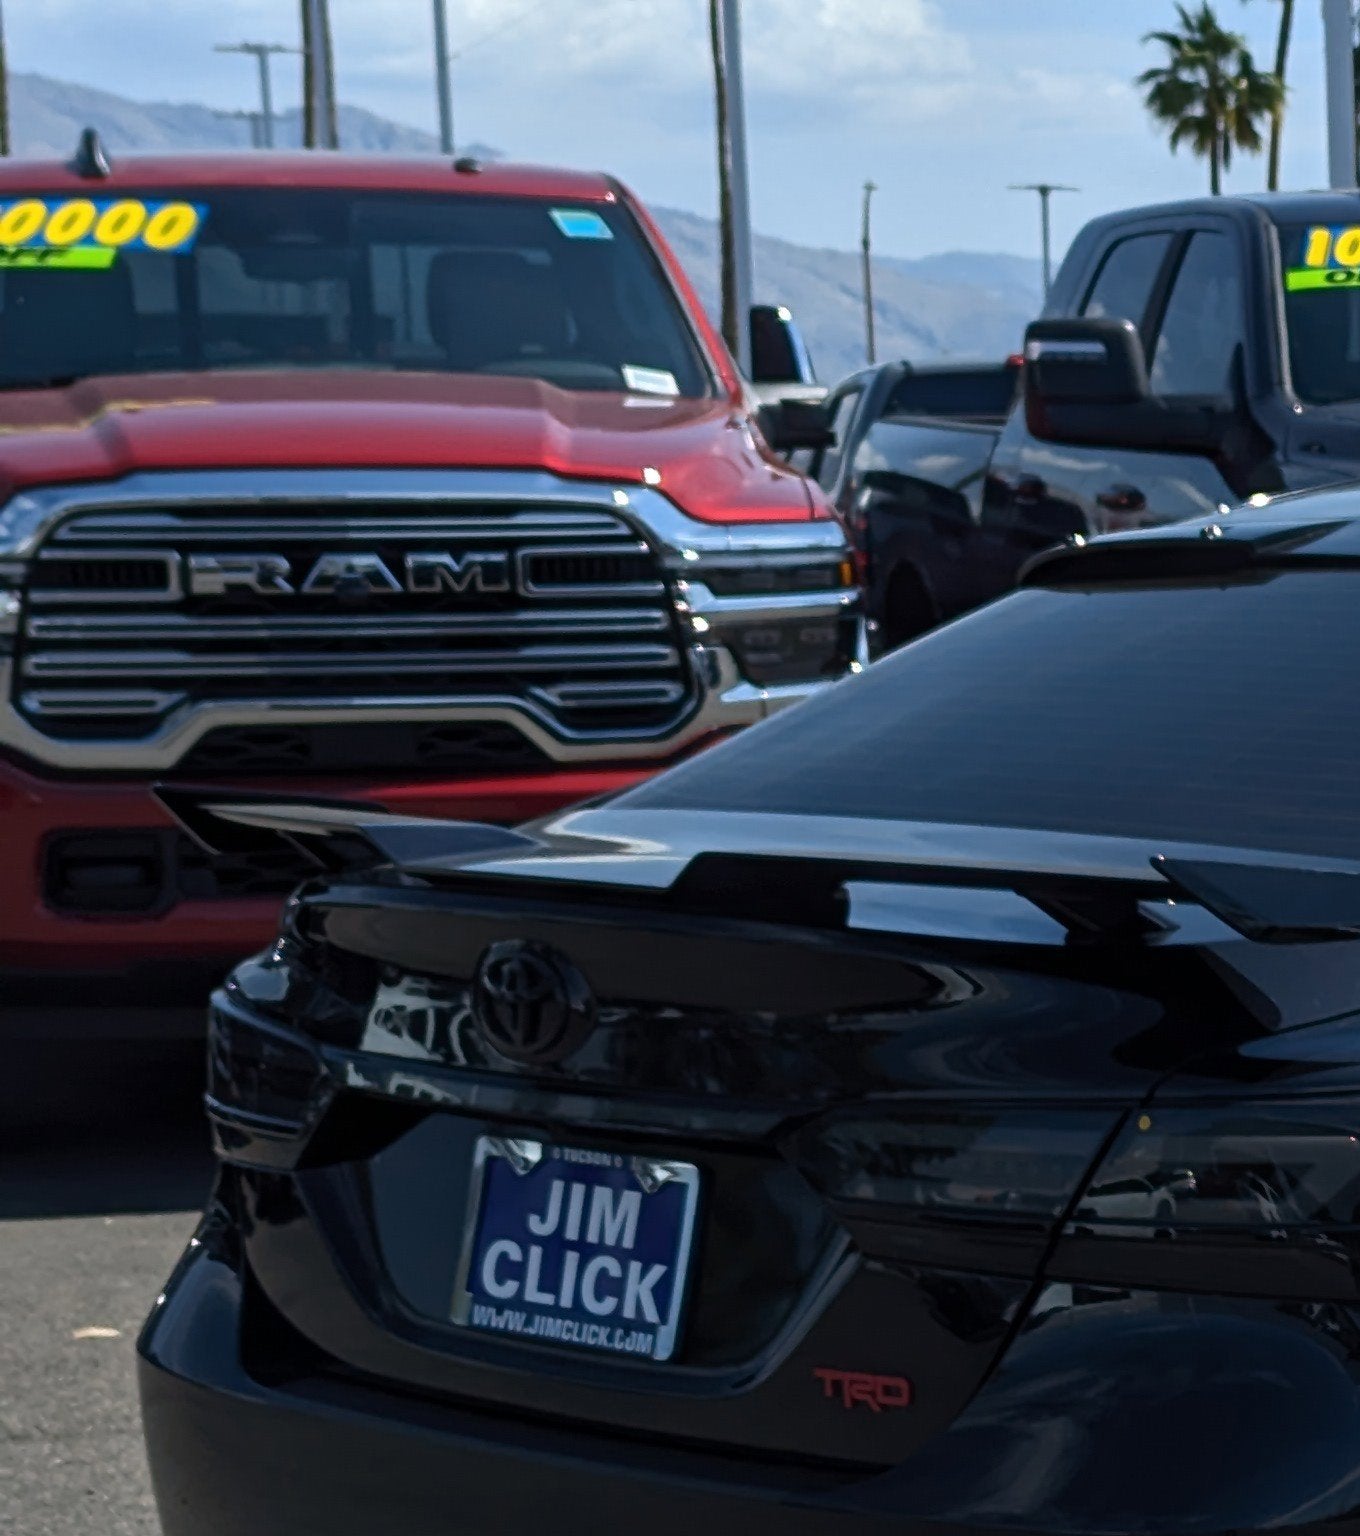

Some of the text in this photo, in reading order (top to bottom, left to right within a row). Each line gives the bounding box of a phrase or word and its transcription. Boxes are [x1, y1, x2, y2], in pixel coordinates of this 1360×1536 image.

[188, 551, 510, 594] RAM
[528, 1179, 643, 1250] JIM
[482, 1239, 668, 1325] CLICK
[813, 1367, 910, 1413] TRD
